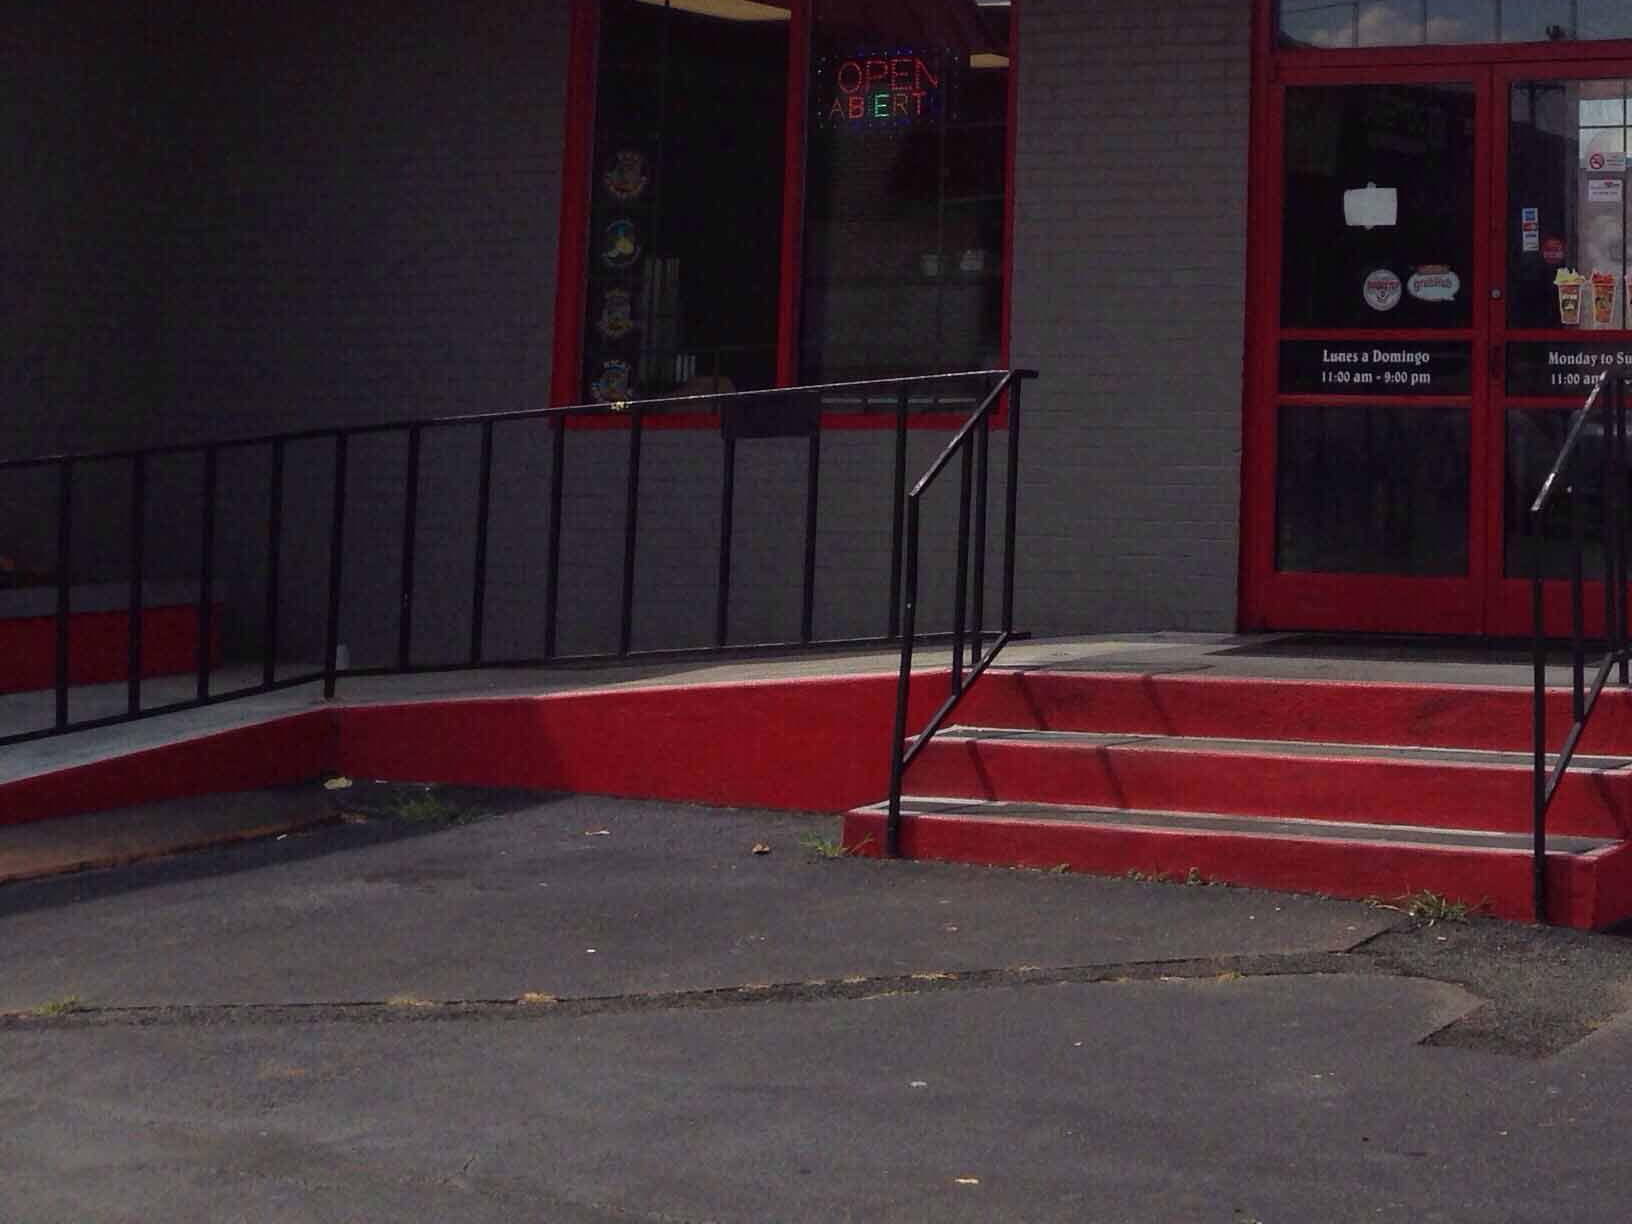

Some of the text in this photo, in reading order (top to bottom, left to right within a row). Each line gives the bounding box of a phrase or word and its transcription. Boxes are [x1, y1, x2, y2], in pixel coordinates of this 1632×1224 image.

[837, 57, 939, 94] OPEN
[1323, 349, 1430, 366] Lunes a Domingo
[1548, 351, 1597, 367] Monday
[1600, 353, 1613, 365] to
[1322, 371, 1351, 384] 11:00
[1353, 373, 1373, 384] am
[1384, 371, 1408, 384] 9:00
[1411, 373, 1431, 387] pm
[1551, 373, 1580, 385] 11:00
